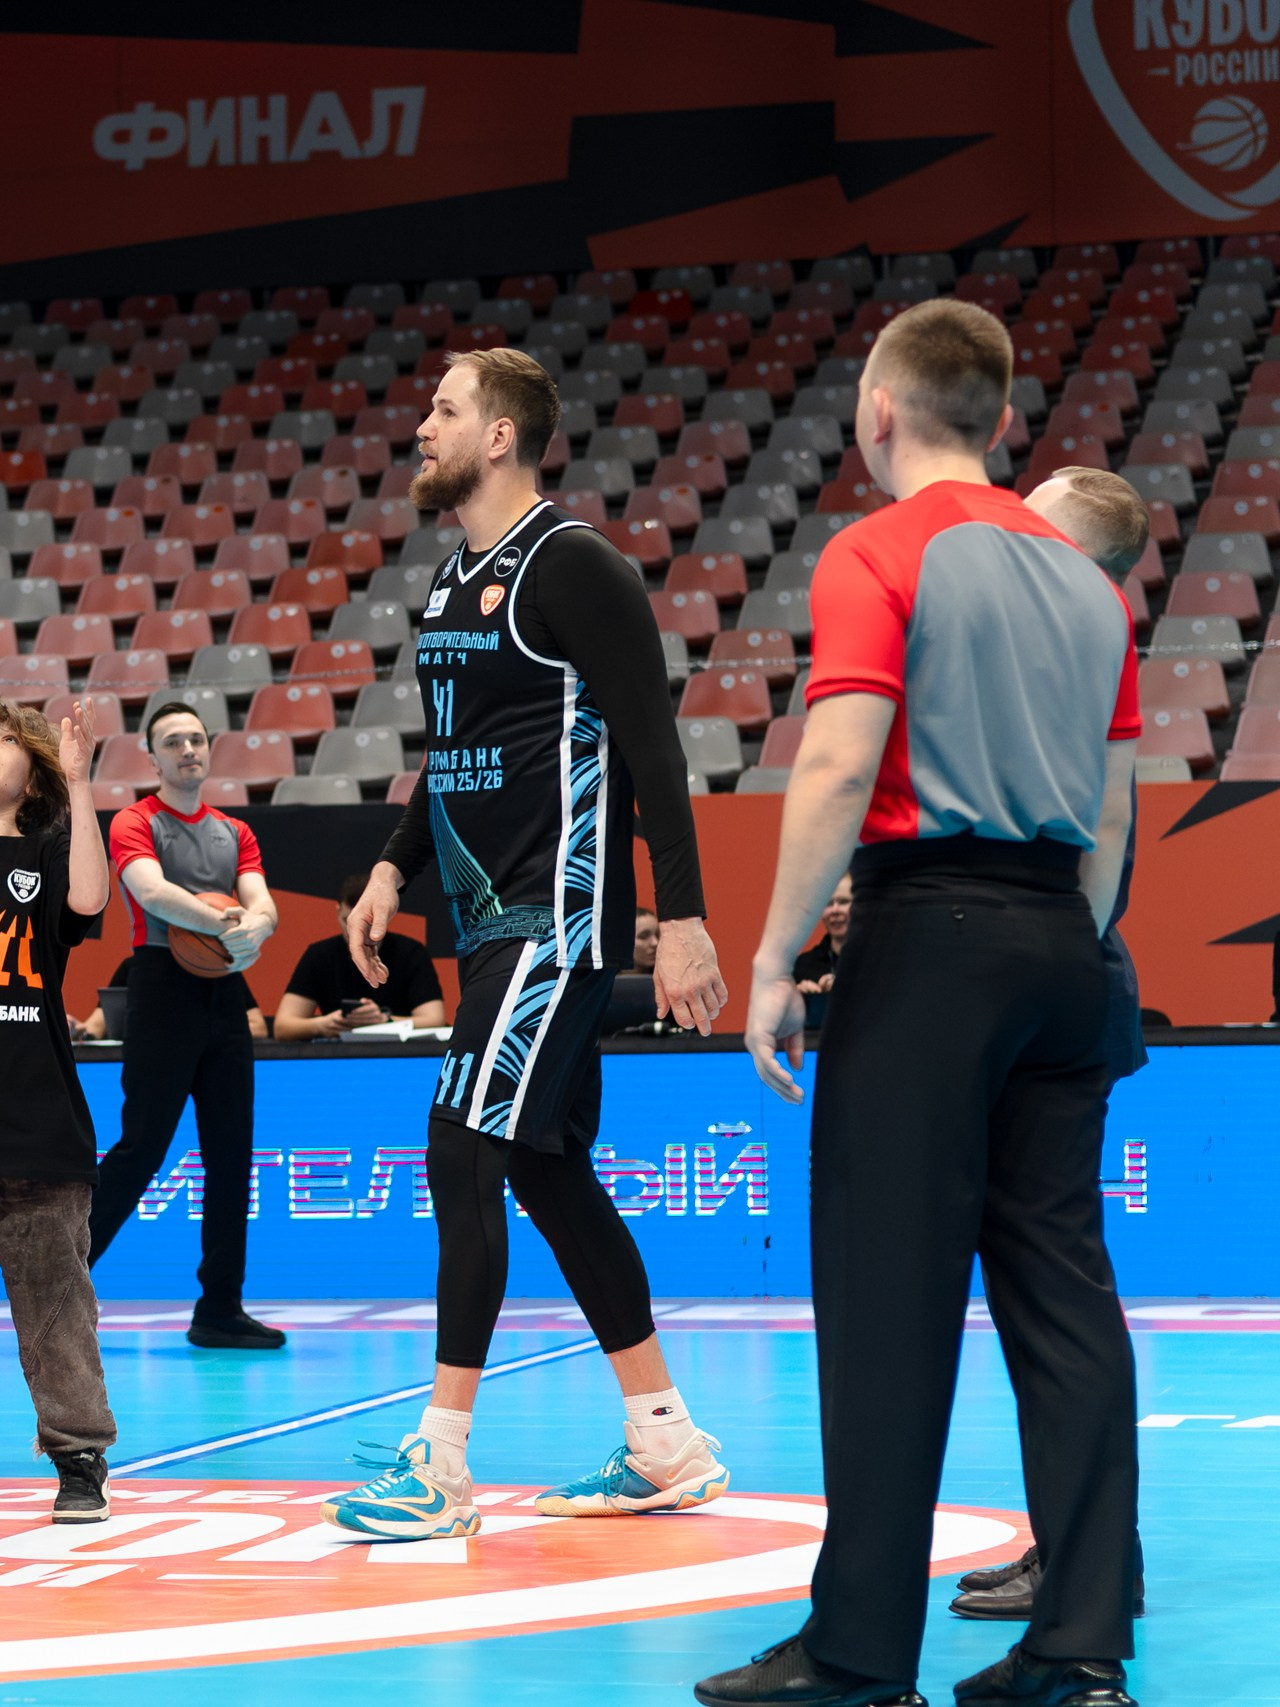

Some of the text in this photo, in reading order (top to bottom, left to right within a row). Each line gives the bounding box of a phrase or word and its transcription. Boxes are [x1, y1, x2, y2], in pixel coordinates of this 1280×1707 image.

[92, 85, 426, 171] ФИНАЛ
[498, 556, 517, 567] РФБ
[419, 651, 467, 665] МАТЧ
[456, 769, 503, 792] 25/26
[435, 1049, 475, 1109] 41
